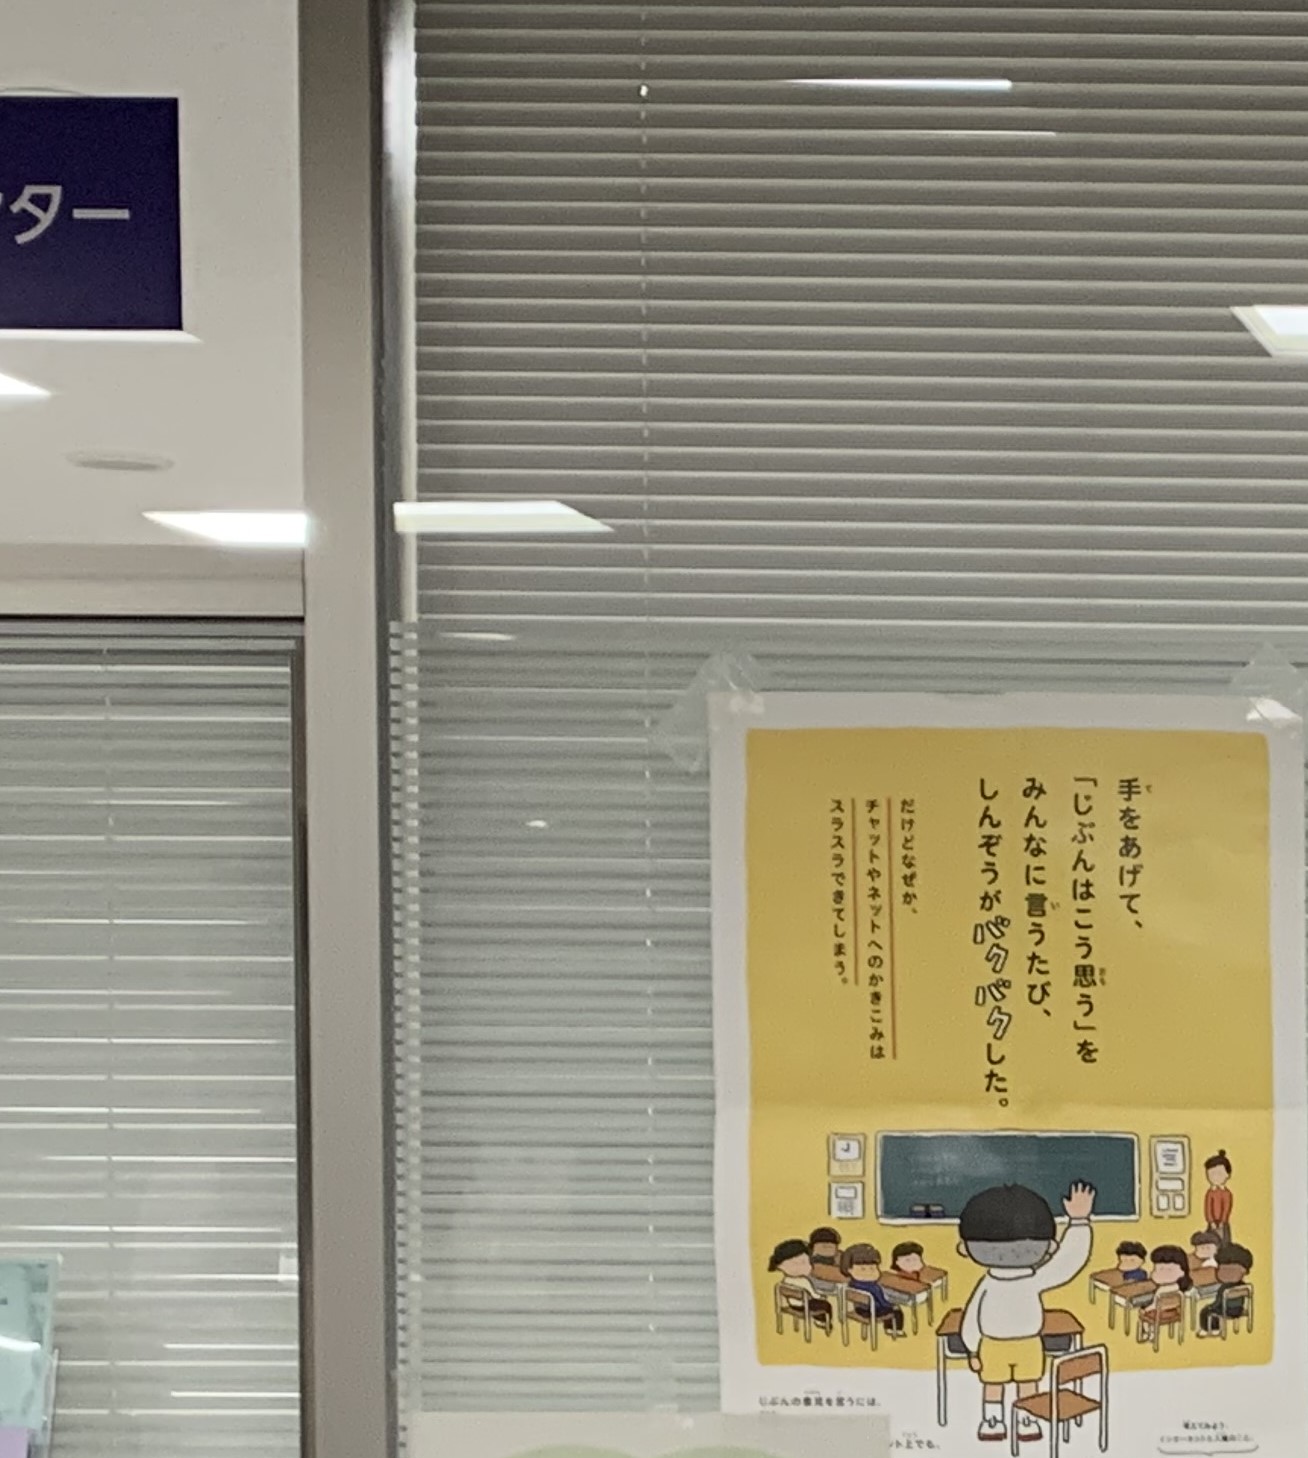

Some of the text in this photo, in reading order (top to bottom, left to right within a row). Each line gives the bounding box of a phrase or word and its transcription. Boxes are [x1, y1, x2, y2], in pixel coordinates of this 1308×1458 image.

[0, 184, 130, 244] ター
[1022, 777, 1052, 1018] みんなに言うたび、
[1070, 776, 1100, 1064] 「じぶんはこう思う」を
[1117, 777, 1144, 929] 手をあげて、
